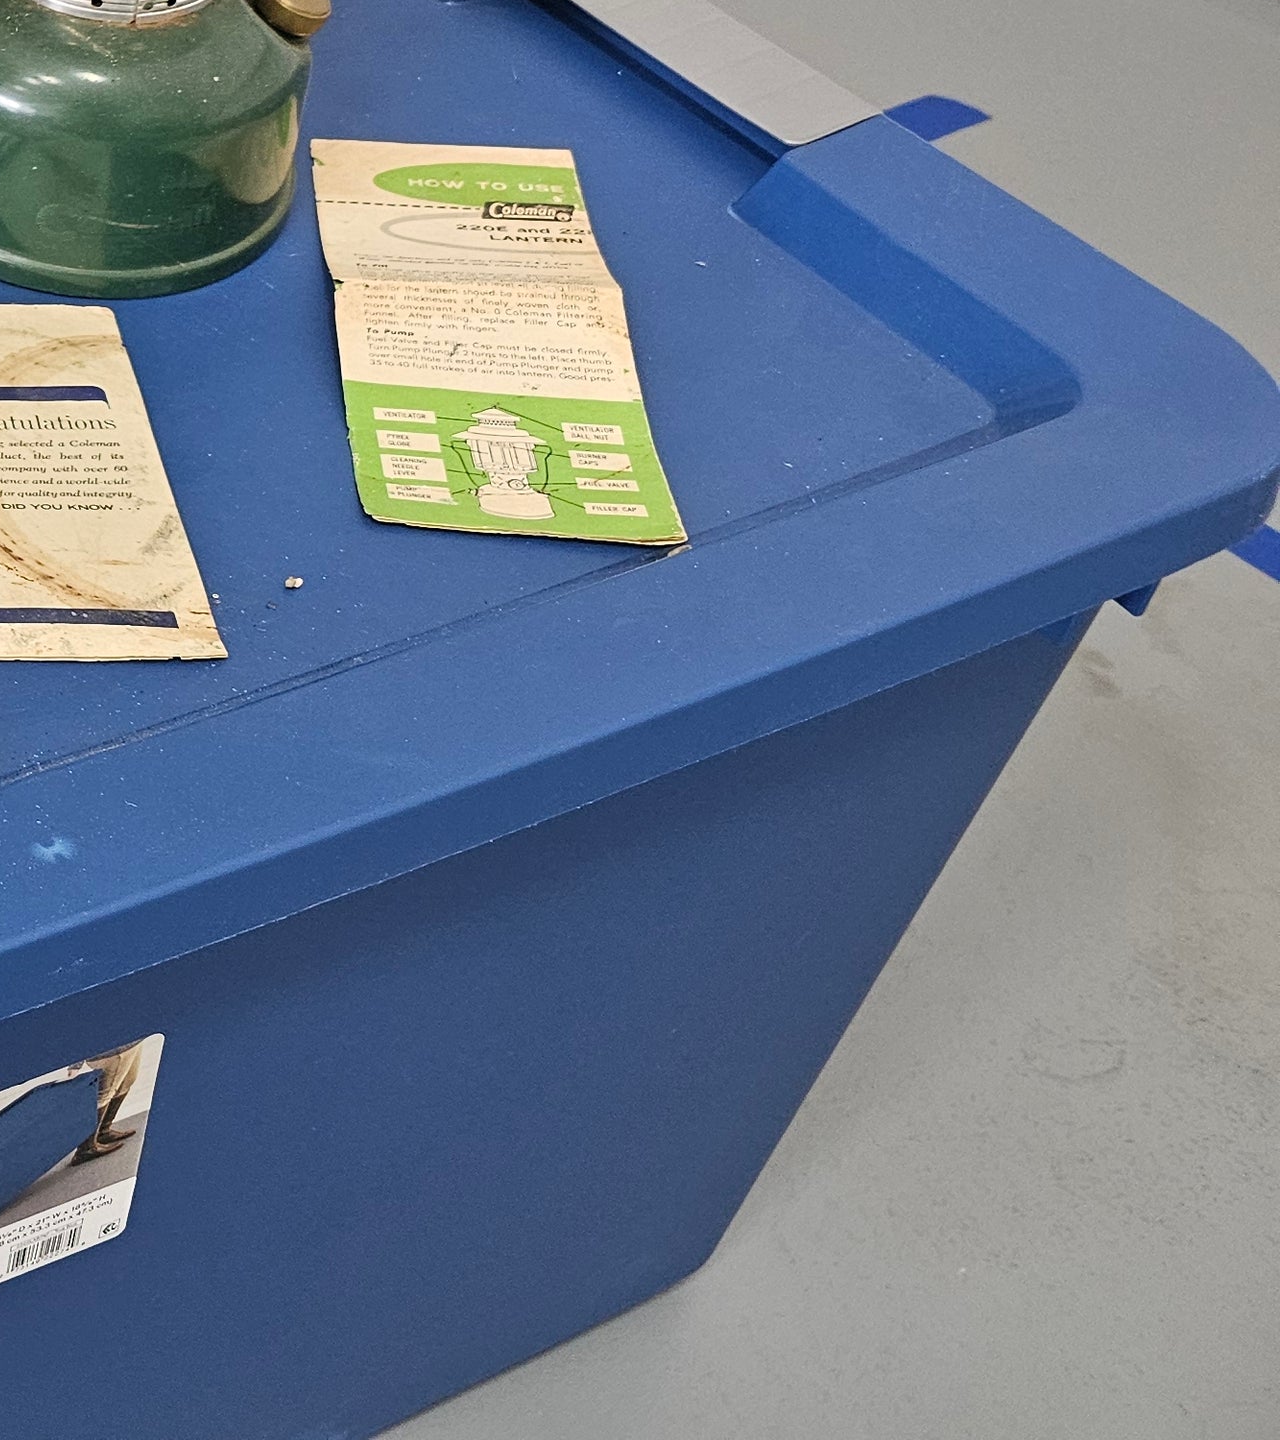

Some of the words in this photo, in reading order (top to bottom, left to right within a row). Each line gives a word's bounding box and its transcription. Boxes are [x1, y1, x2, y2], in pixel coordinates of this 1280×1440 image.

[408, 178, 464, 189] HOW
[476, 181, 507, 191] TO
[518, 183, 564, 193] USE
[489, 203, 556, 220] Coleman
[490, 235, 583, 243] LANTERN
